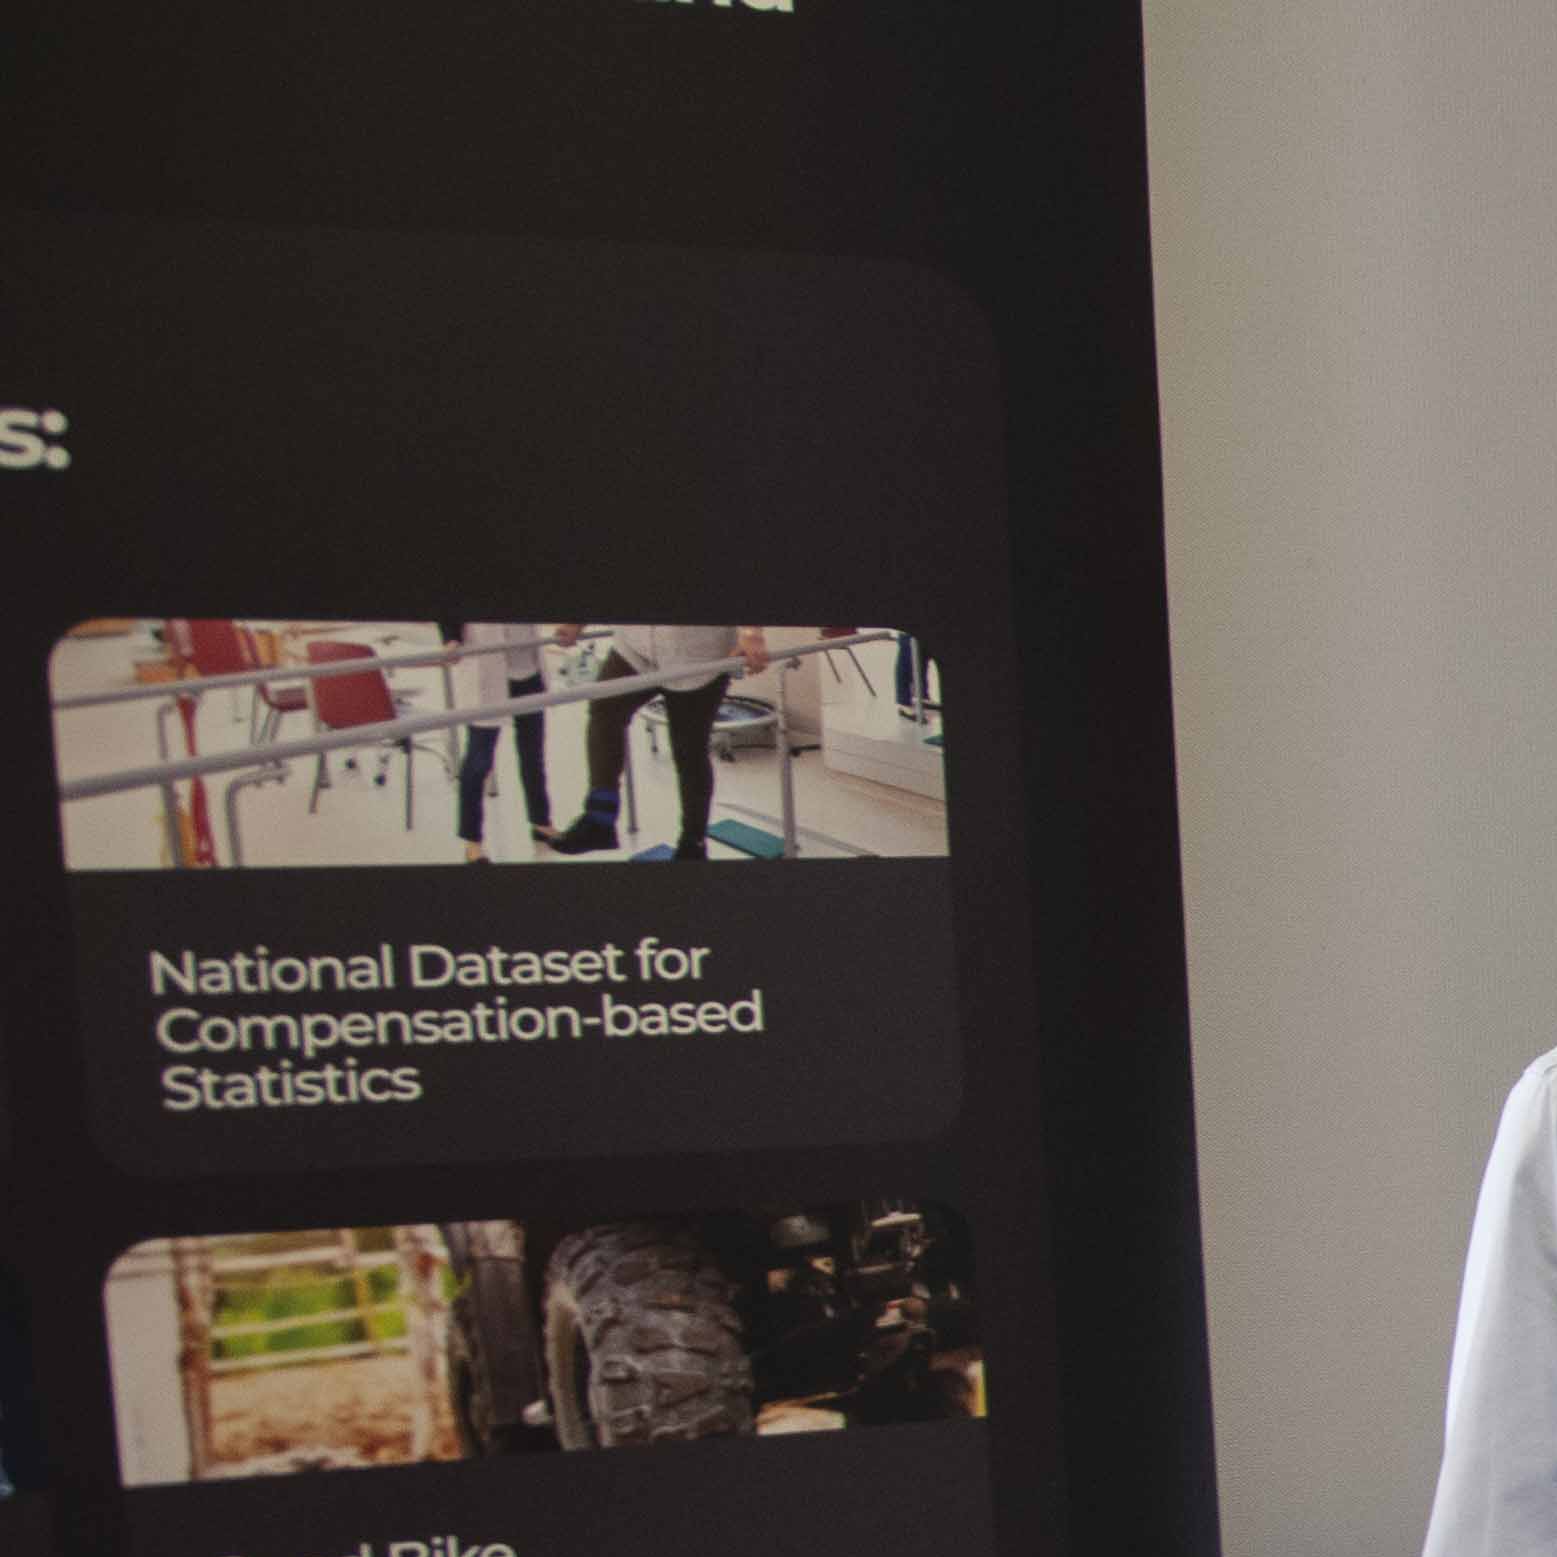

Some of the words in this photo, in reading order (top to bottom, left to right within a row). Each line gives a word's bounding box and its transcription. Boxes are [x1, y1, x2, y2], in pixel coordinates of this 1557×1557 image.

[151, 944, 394, 994] National
[410, 944, 627, 987] Dataset
[635, 937, 710, 980] for
[157, 989, 763, 1057] Compensation-based
[163, 1058, 421, 1110] Statistics
